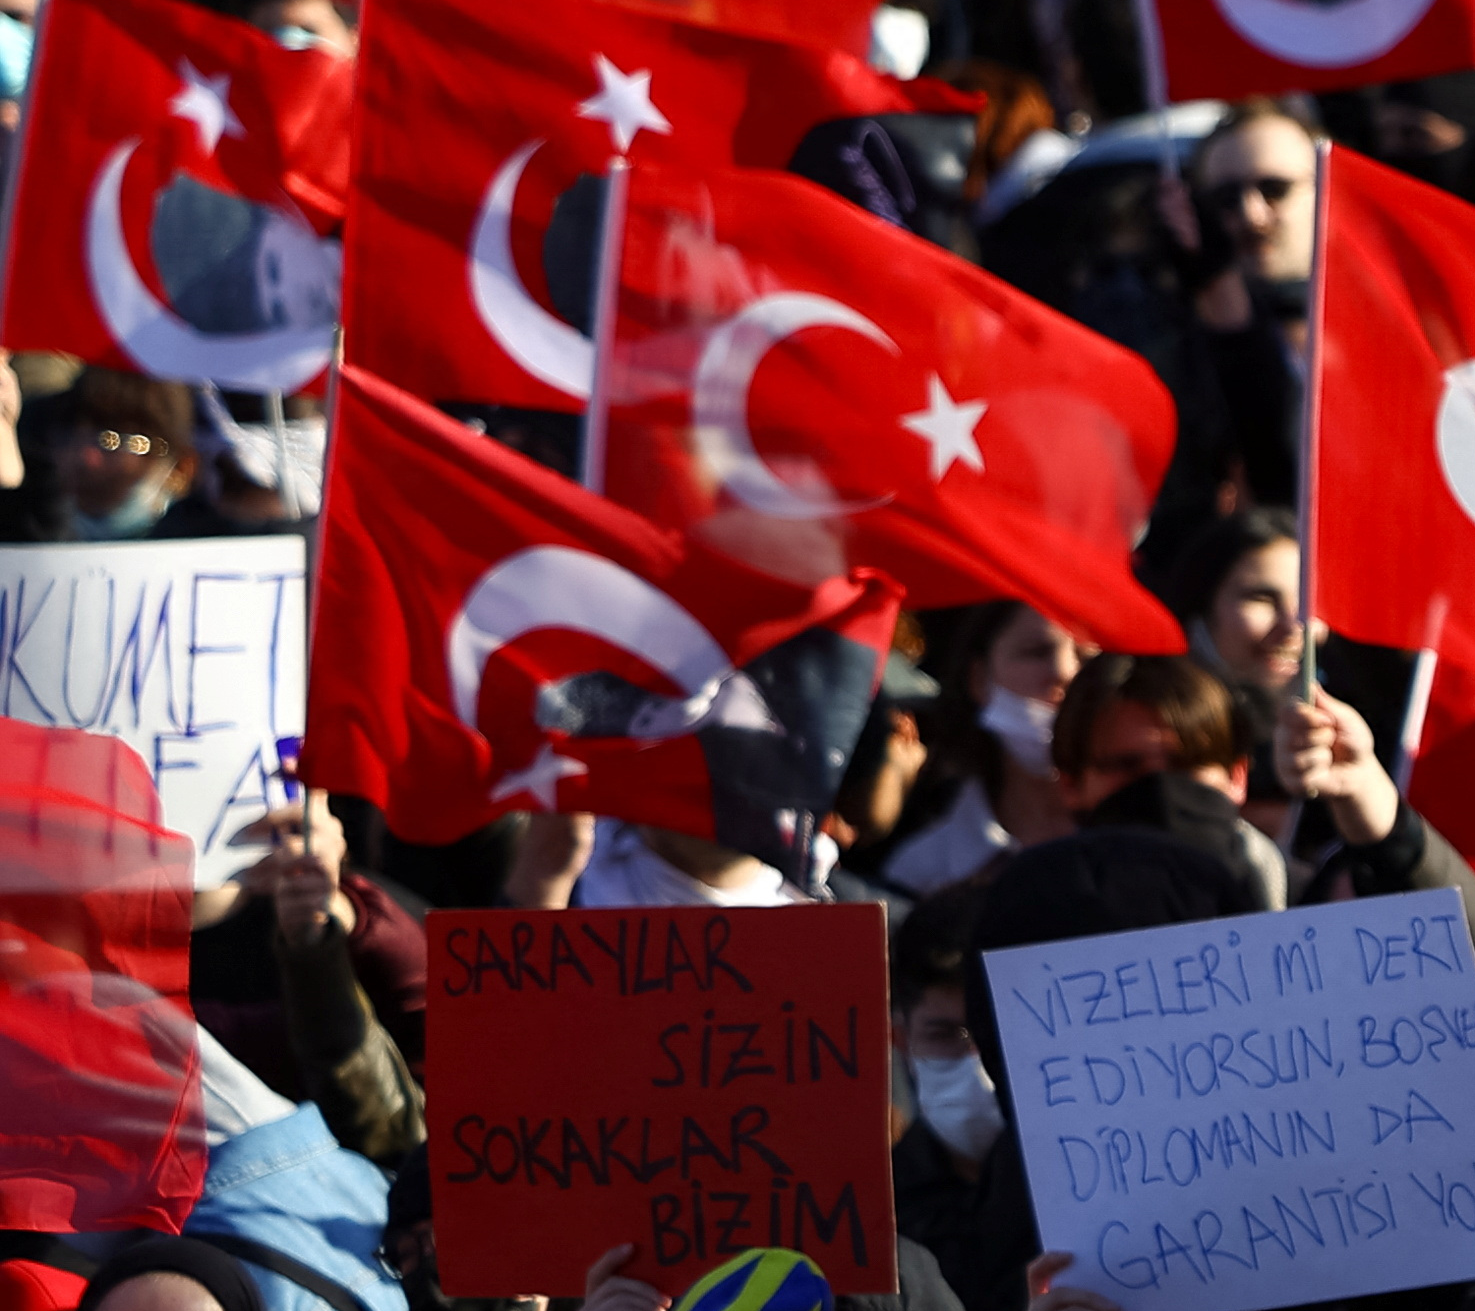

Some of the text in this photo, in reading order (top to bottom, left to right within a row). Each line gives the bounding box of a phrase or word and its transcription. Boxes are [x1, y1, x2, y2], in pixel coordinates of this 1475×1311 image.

[0, 564, 305, 737] KÜMET
[443, 915, 754, 997] SARAYLAR
[1013, 914, 1465, 1037] VİZELERİ Mİ DERT
[650, 1000, 860, 1088] SİZİN
[446, 1105, 795, 1190] SOKAKLAR
[1058, 1087, 1456, 1203] DİPLOMANIN DA
[650, 1177, 869, 1268] BİZİM
